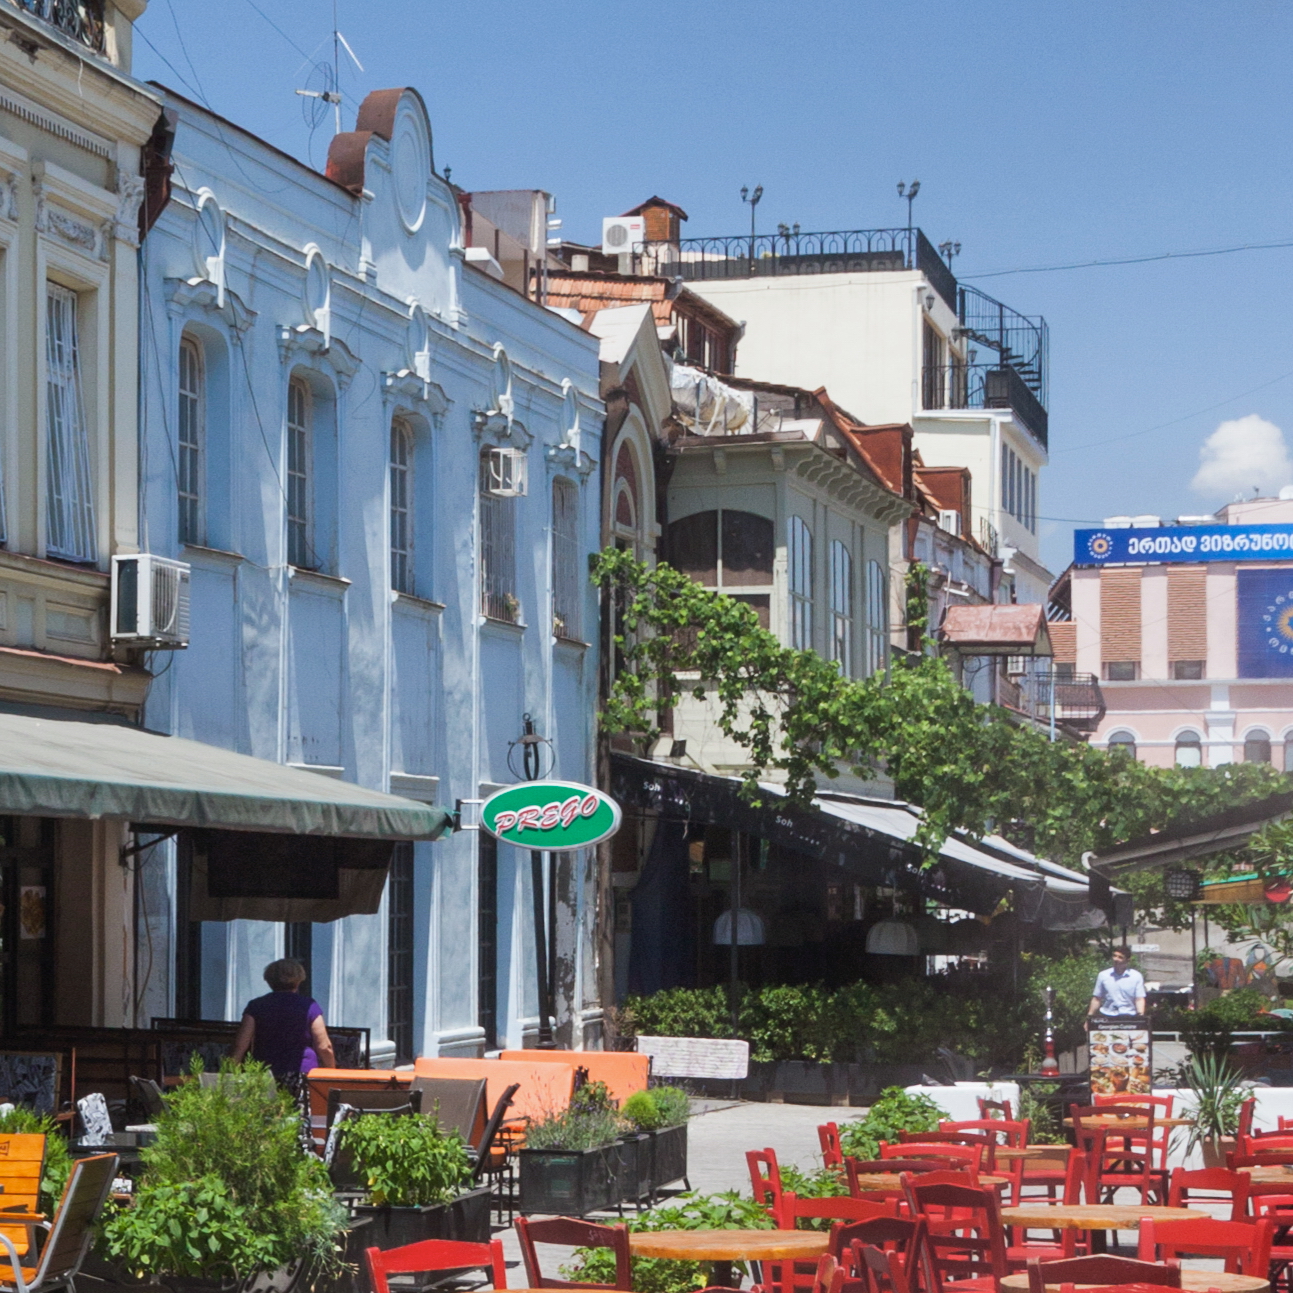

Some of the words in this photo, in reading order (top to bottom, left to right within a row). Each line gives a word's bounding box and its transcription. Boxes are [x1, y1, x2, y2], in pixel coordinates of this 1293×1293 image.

[1128, 536, 1196, 554] ერთად
[1200, 533, 1293, 552] ვიზრუნო
[494, 793, 600, 837] PREGO
